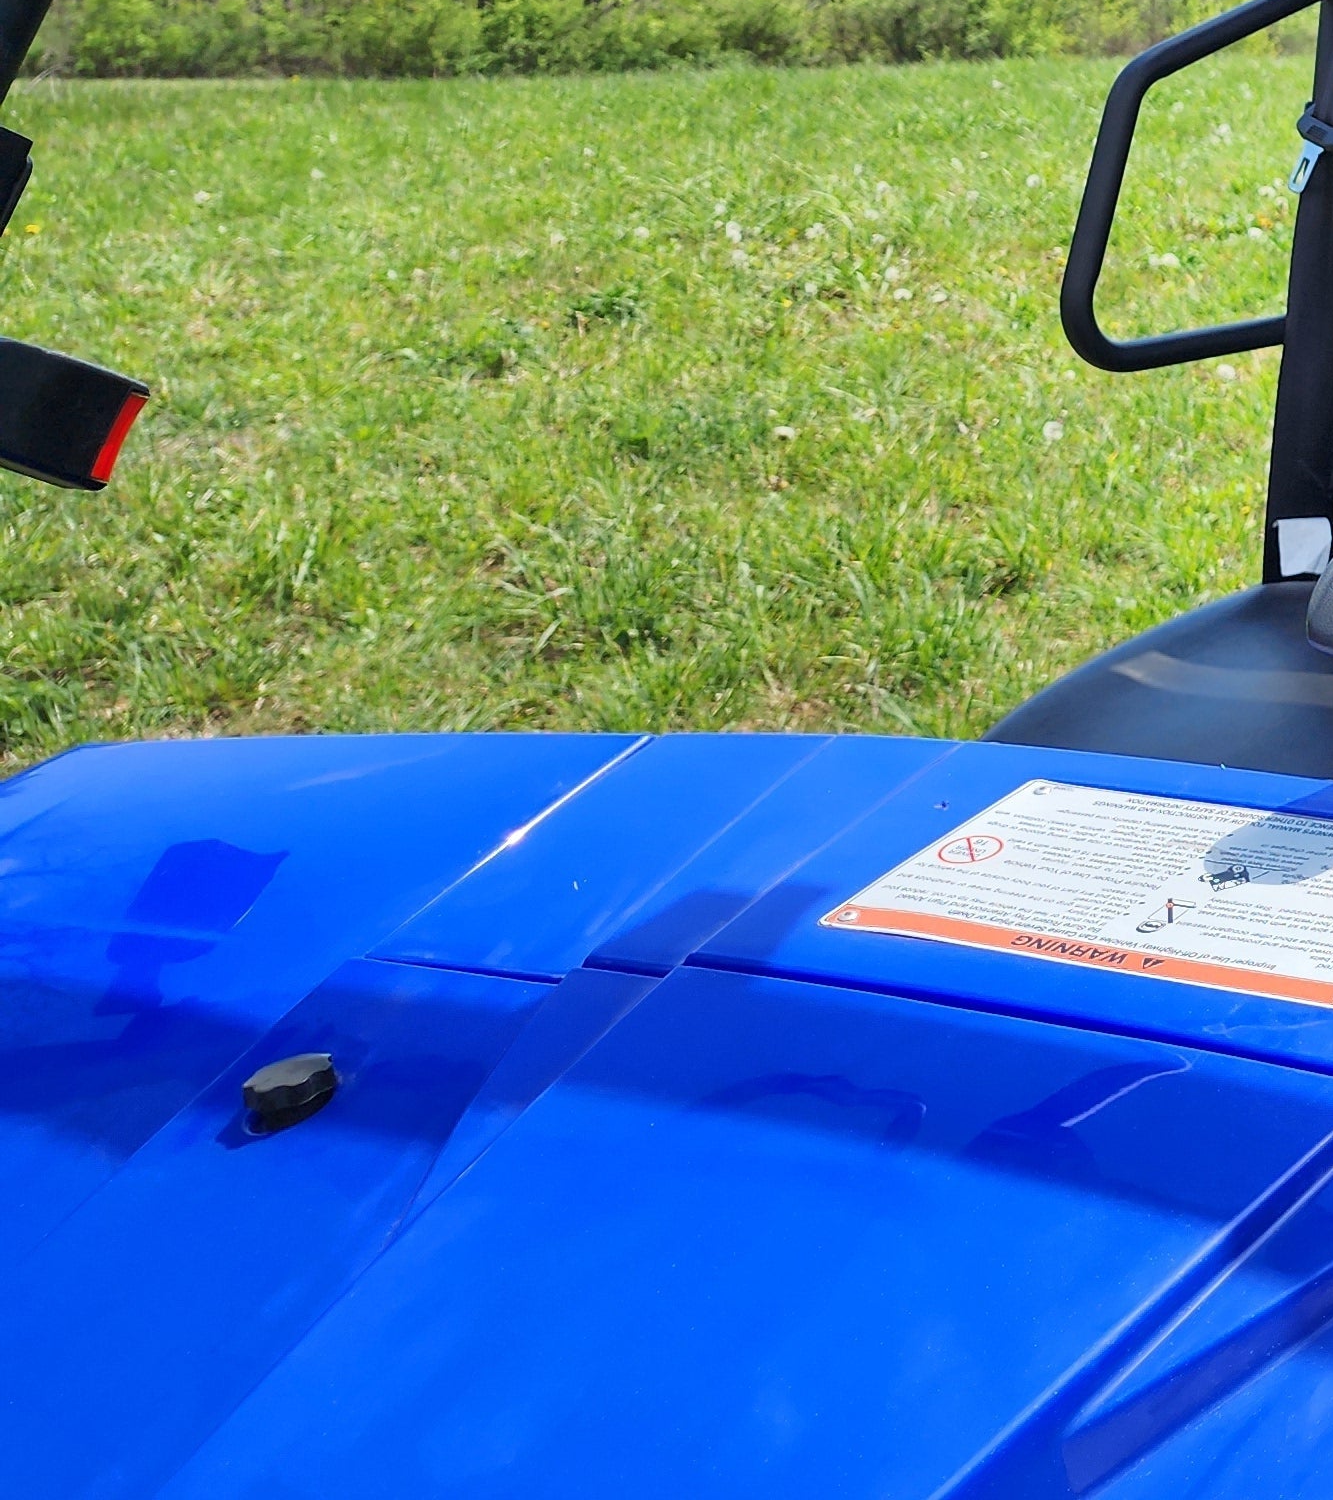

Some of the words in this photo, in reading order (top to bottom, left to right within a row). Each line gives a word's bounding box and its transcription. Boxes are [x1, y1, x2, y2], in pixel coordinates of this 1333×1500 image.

[1090, 800, 1139, 811] WARNINGS
[1122, 797, 1185, 810] INFORMATION
[1153, 808, 1214, 821] INSTRUCTION
[1180, 805, 1217, 814] SAFETY
[1227, 811, 1267, 821] SOURCE
[1261, 816, 1297, 825] OTHER
[1227, 818, 1267, 828] FOLLOW
[1262, 823, 1303, 833] MANUAL
[893, 892, 927, 902] Ahead
[922, 897, 950, 906] Plan
[944, 901, 969, 909] and
[963, 905, 1014, 917] Attention
[970, 913, 990, 921] or
[984, 915, 1018, 926] Injury
[1009, 913, 1032, 921] Pay
[1027, 916, 1064, 926] Riders
[1011, 919, 1051, 932] Severe
[1059, 922, 1088, 930] Sure
[1043, 925, 1082, 937] Cause
[1075, 930, 1102, 940] Can
[1096, 934, 1144, 947] Vehicles
[1004, 934, 1134, 965] WARNING
[1196, 950, 1214, 959] of
[1208, 952, 1234, 963] Use
[1226, 955, 1280, 970] Improper
